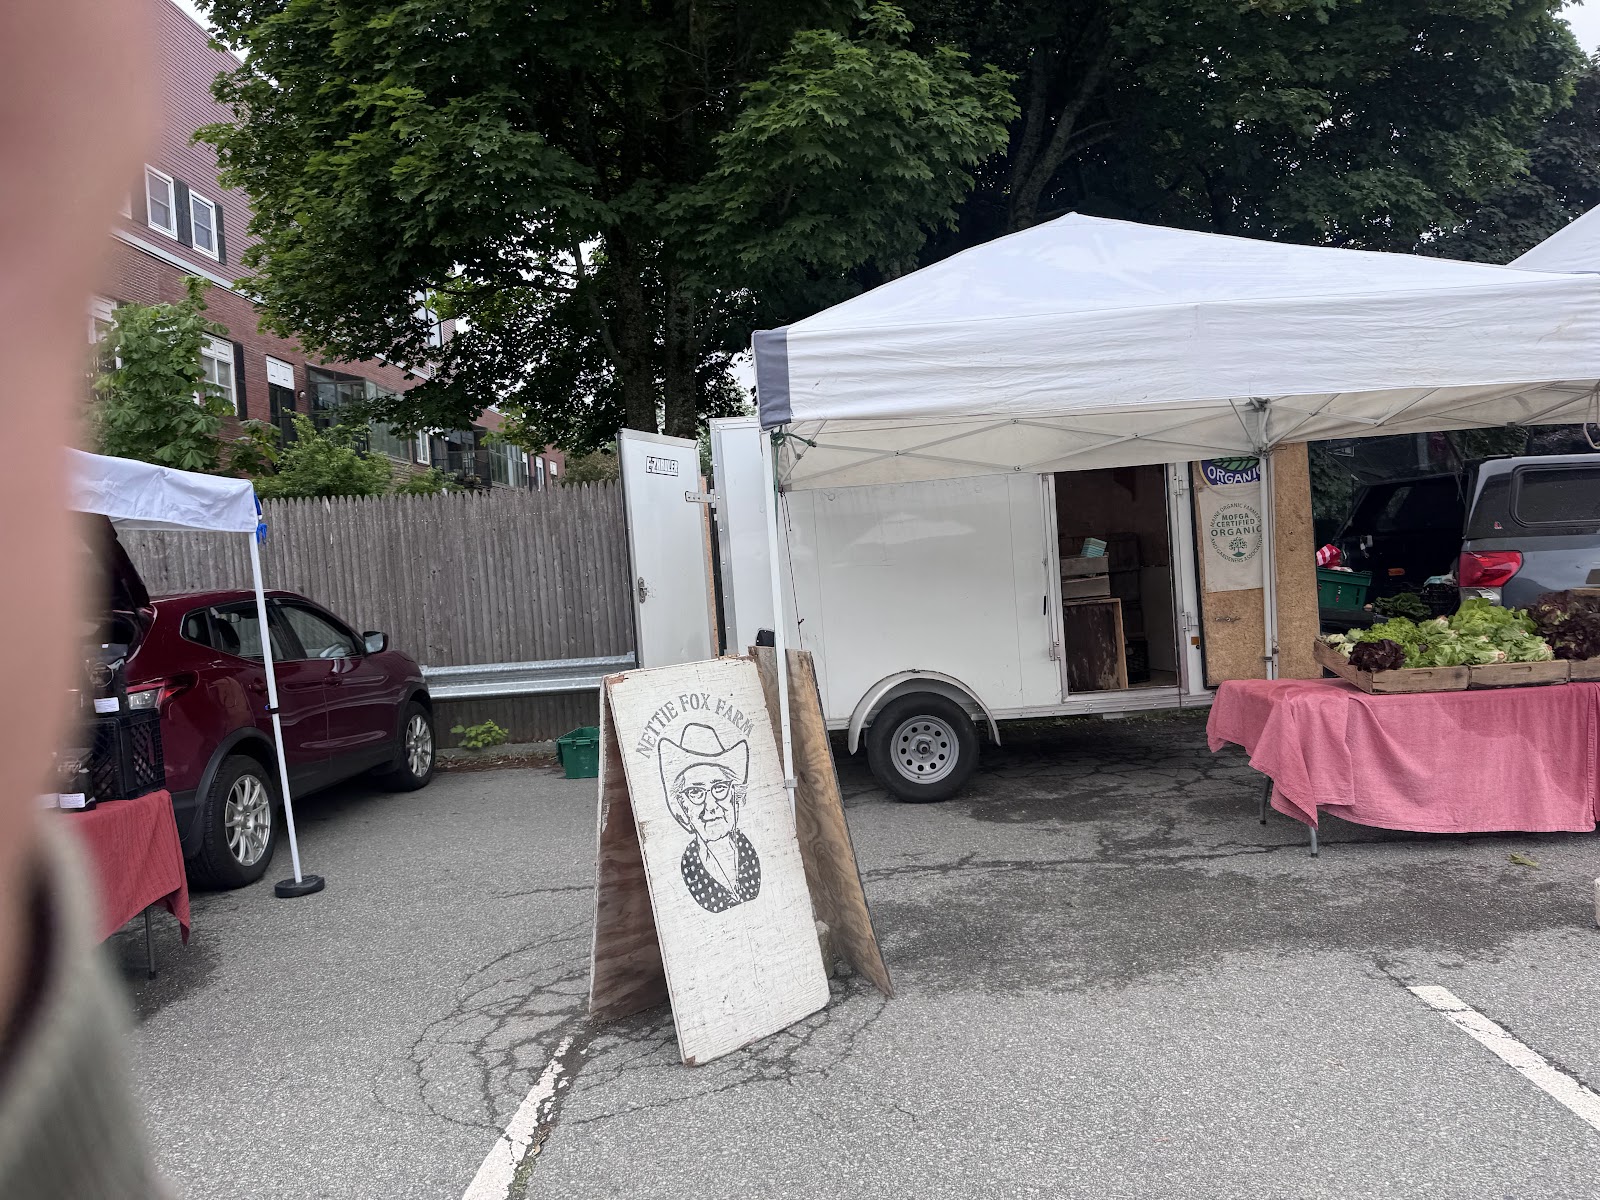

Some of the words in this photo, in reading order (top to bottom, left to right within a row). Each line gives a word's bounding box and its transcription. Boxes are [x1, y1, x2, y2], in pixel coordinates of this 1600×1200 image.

[1210, 510, 1221, 527] MAINE
[1220, 502, 1243, 512] ORGANIC
[1221, 512, 1249, 521] MOFGA
[1216, 518, 1255, 528] CERTIFIED
[1210, 525, 1262, 537] ORGANIC
[635, 701, 679, 760] NETTIE
[678, 692, 711, 713] FOX
[714, 698, 755, 738] FARM
